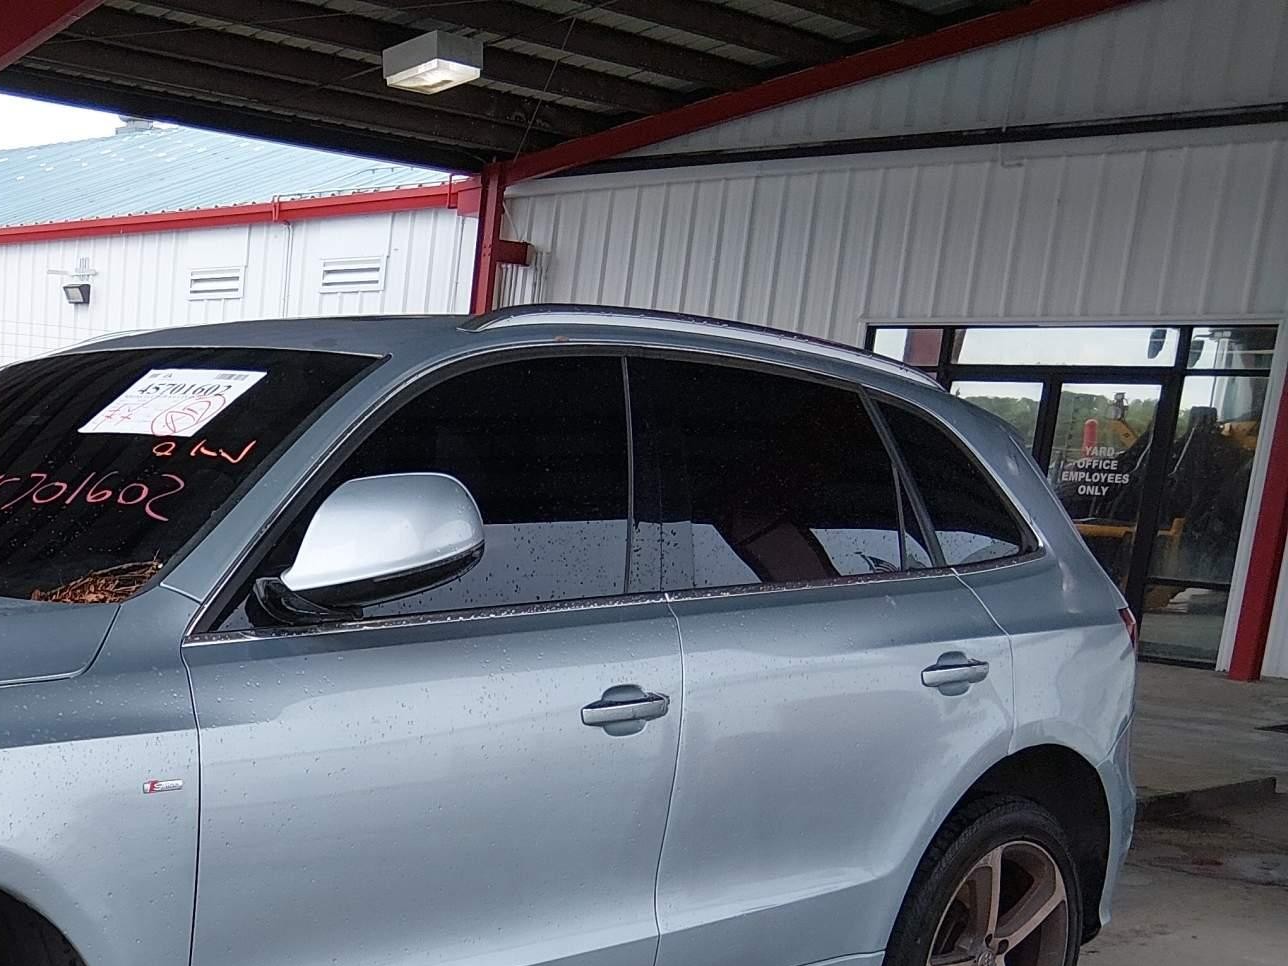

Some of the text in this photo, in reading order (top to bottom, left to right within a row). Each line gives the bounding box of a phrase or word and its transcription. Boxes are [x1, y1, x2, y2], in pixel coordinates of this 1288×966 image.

[137, 383, 233, 396] 45701602
[1085, 446, 1115, 457] YARD
[1077, 459, 1118, 470] OFFICE
[1061, 471, 1130, 484] EMPLOYEES
[1077, 484, 1109, 496] ONLY
